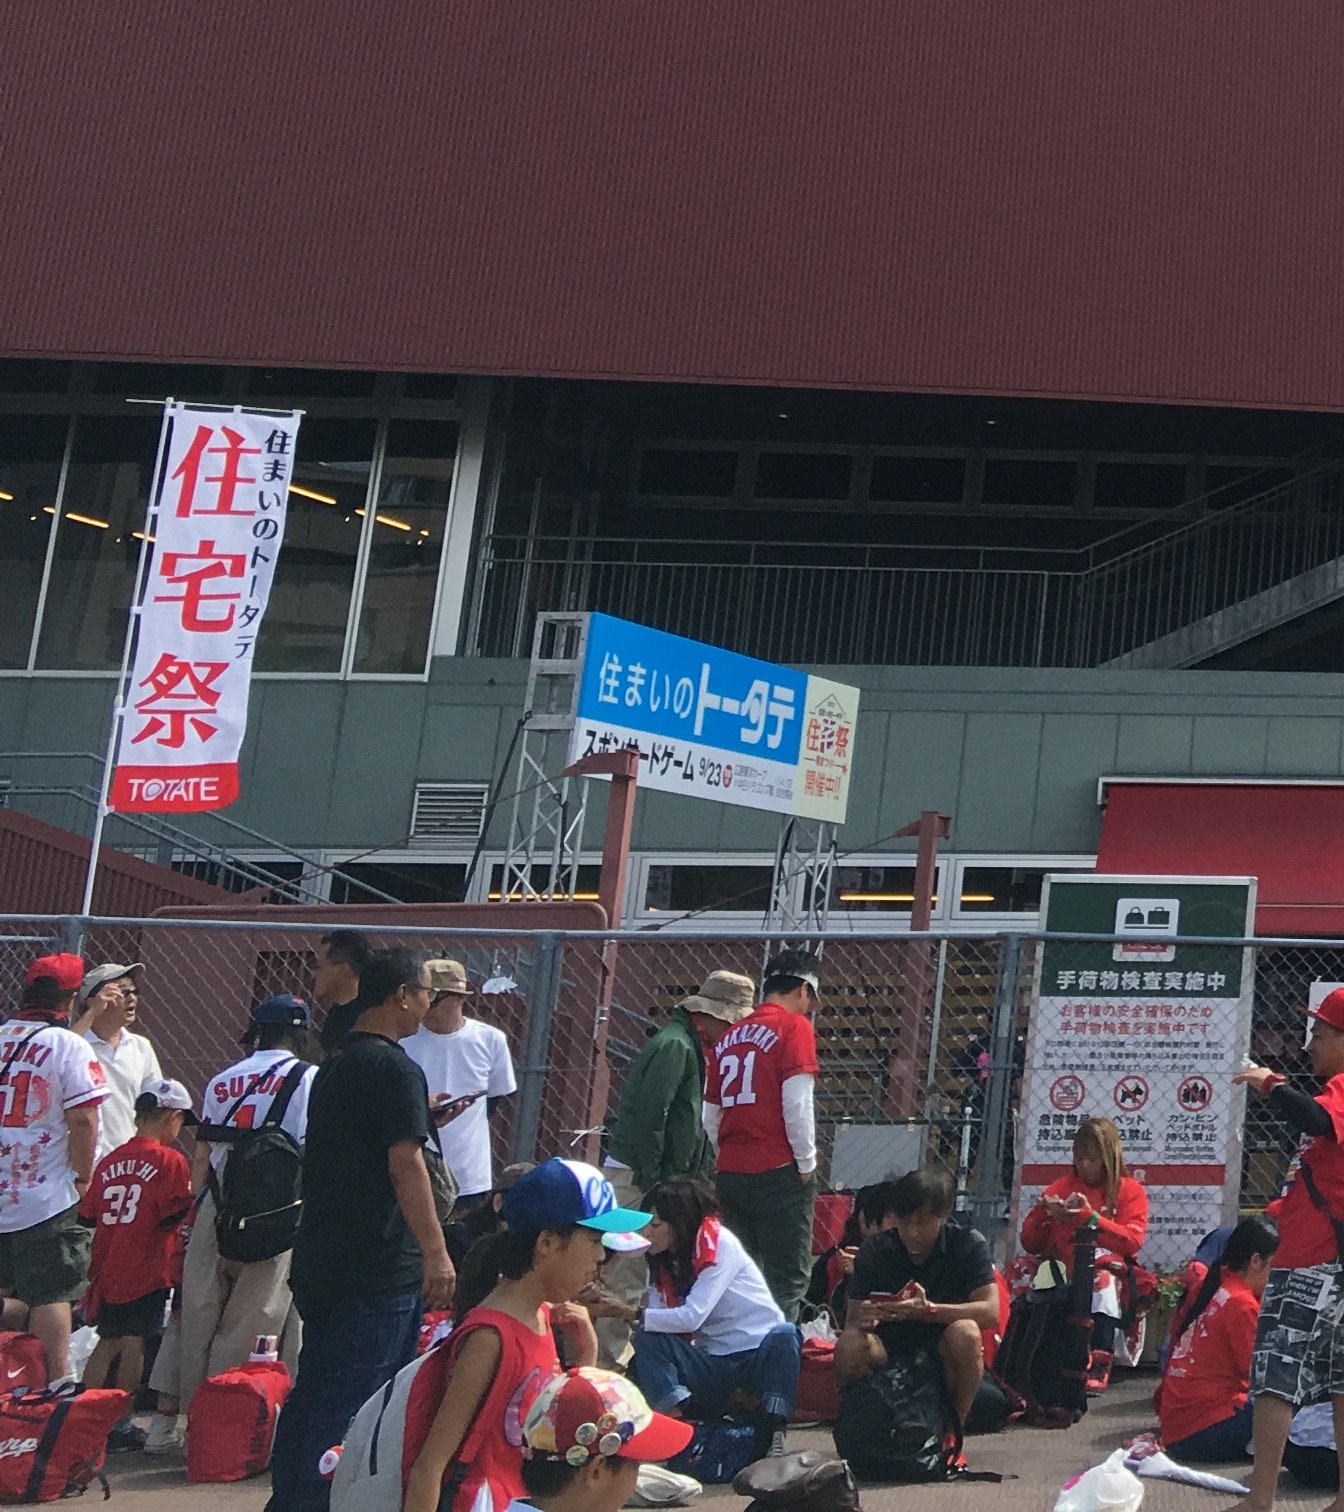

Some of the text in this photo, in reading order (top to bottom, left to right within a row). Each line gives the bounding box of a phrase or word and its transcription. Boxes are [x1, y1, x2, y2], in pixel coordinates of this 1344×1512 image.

[234, 428, 293, 660] 住まいのトータテ
[130, 423, 262, 749] 住宅祭
[598, 651, 796, 750] 住まいのトータテ
[127, 776, 220, 802] TOTATE
[1056, 970, 1226, 992] 手荷物検査実施中
[719, 1051, 757, 1108] 21
